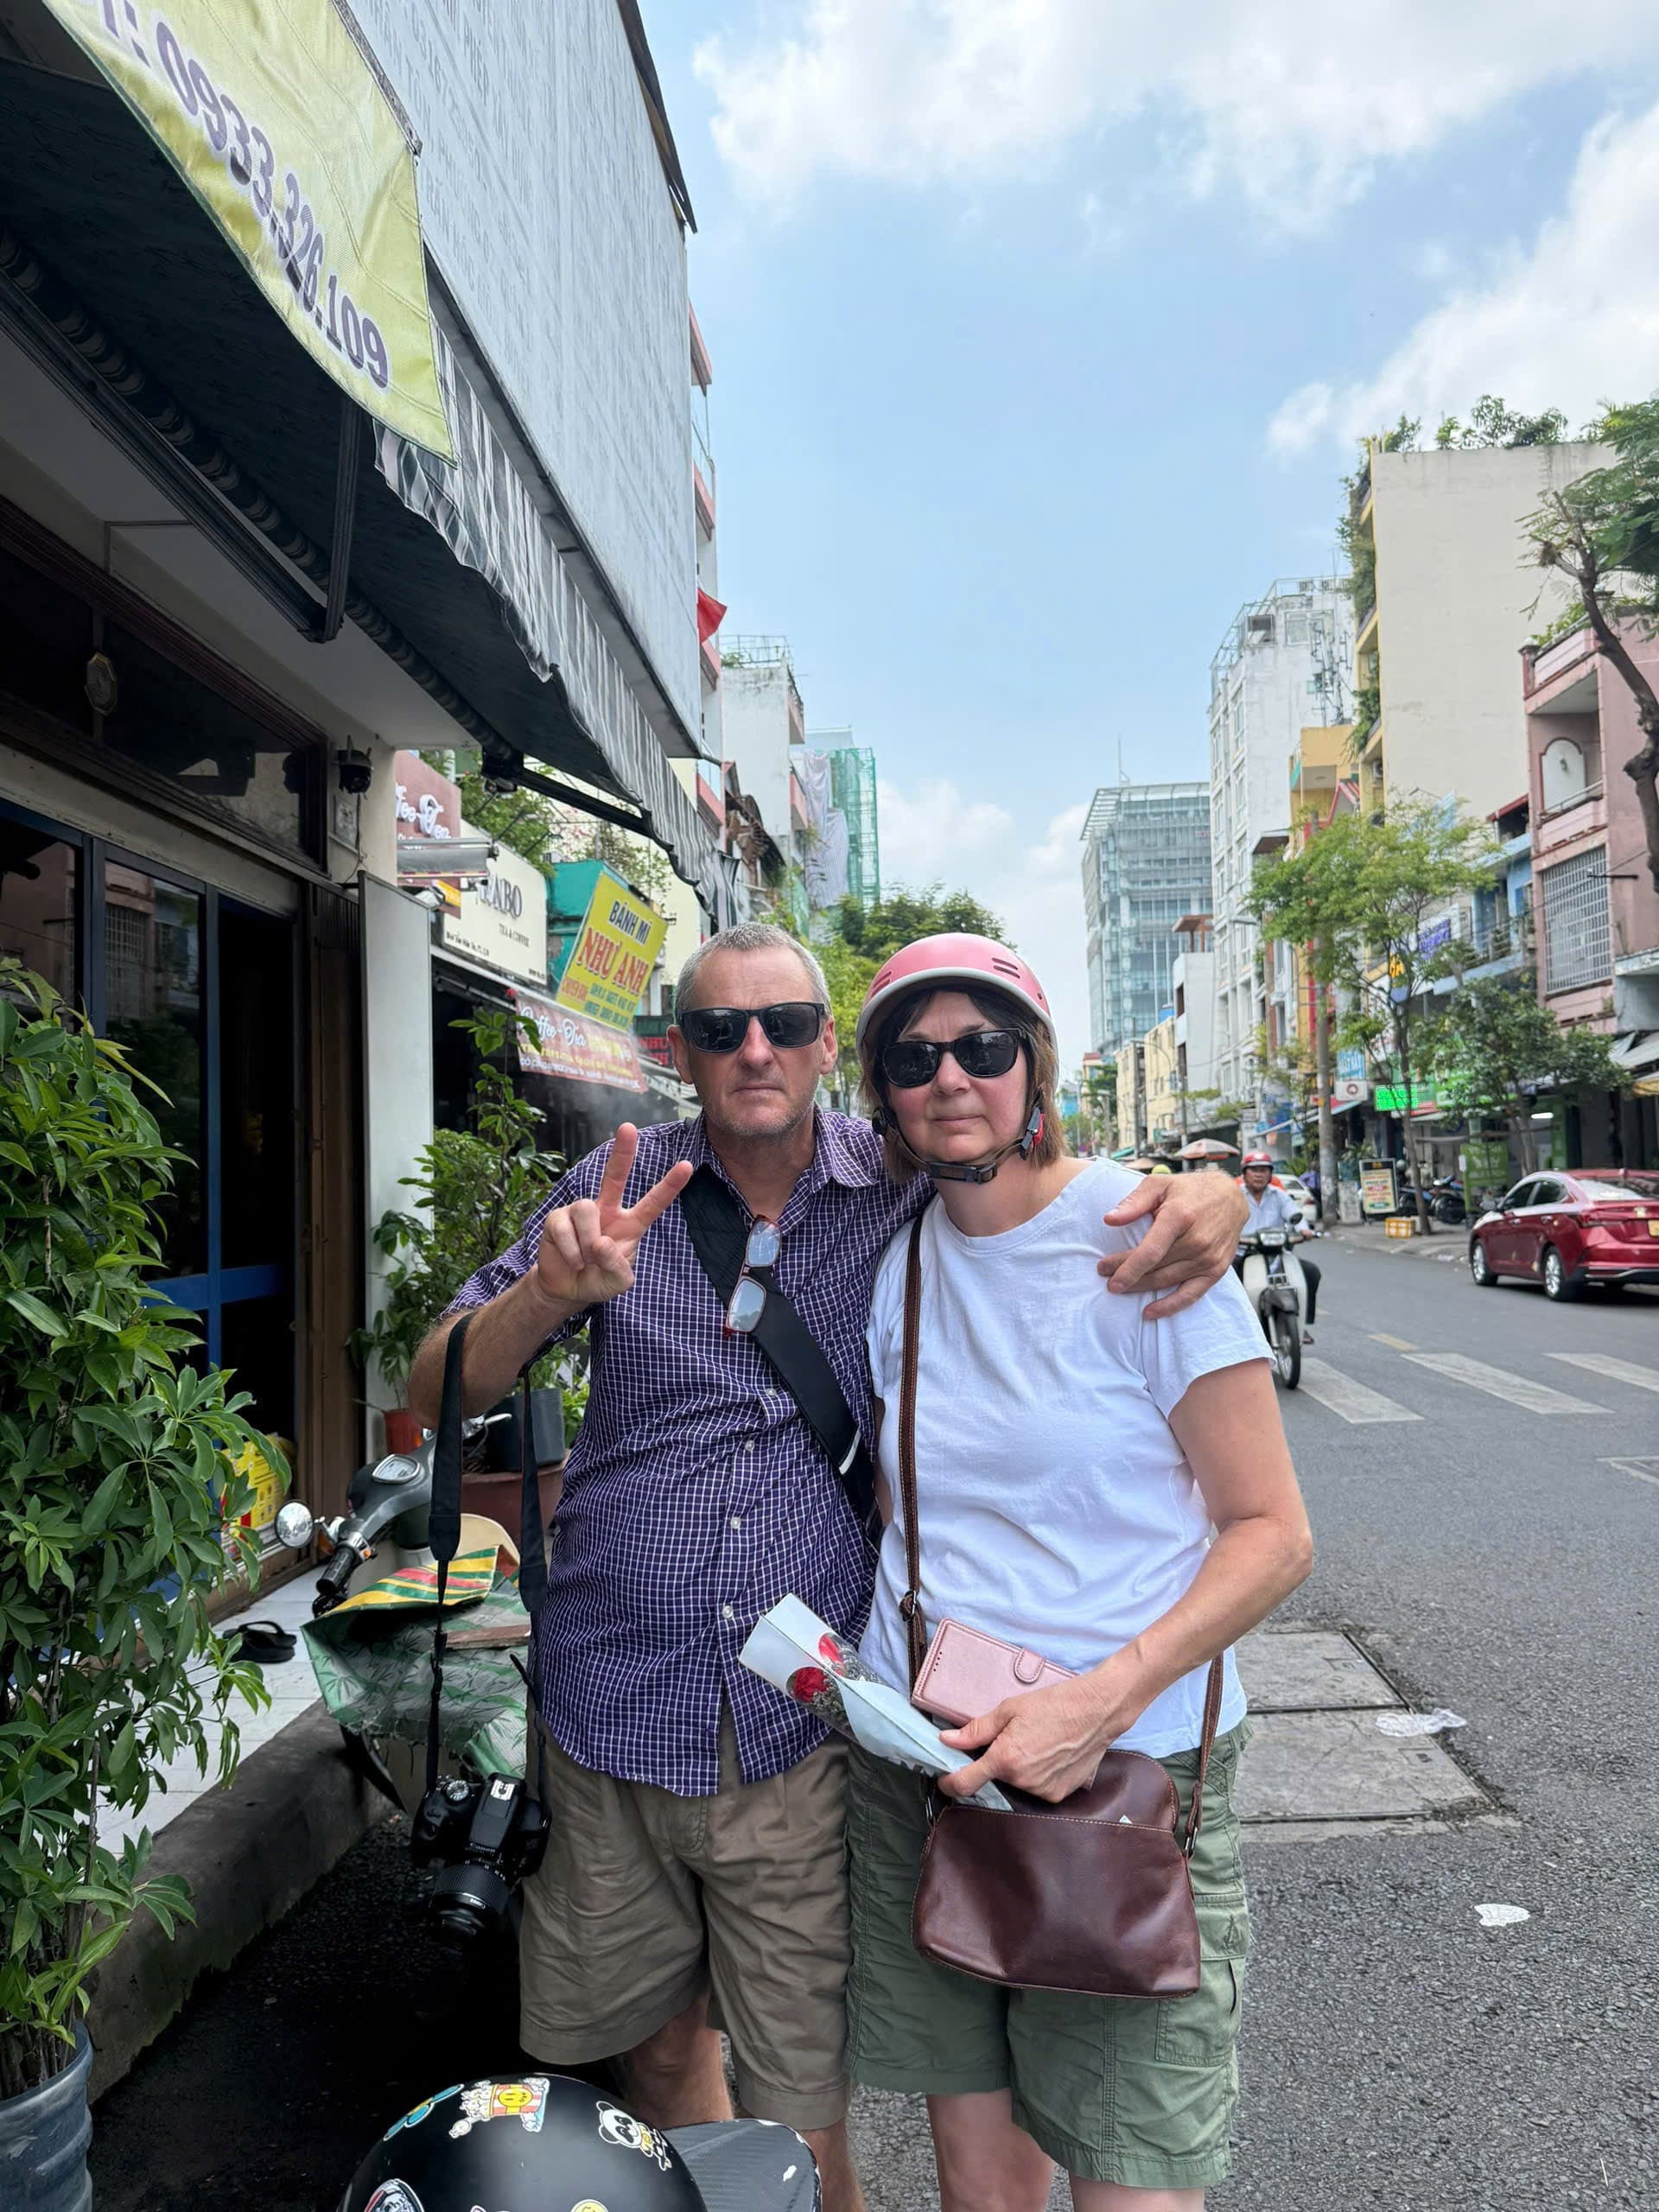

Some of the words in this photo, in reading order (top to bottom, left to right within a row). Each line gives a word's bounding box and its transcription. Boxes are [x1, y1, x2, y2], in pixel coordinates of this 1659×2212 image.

[156, 22, 389, 388] 0933.326.109
[608, 901, 639, 938] BÁNH
[576, 926, 623, 980] NHƯ
[612, 950, 650, 997] ANH
